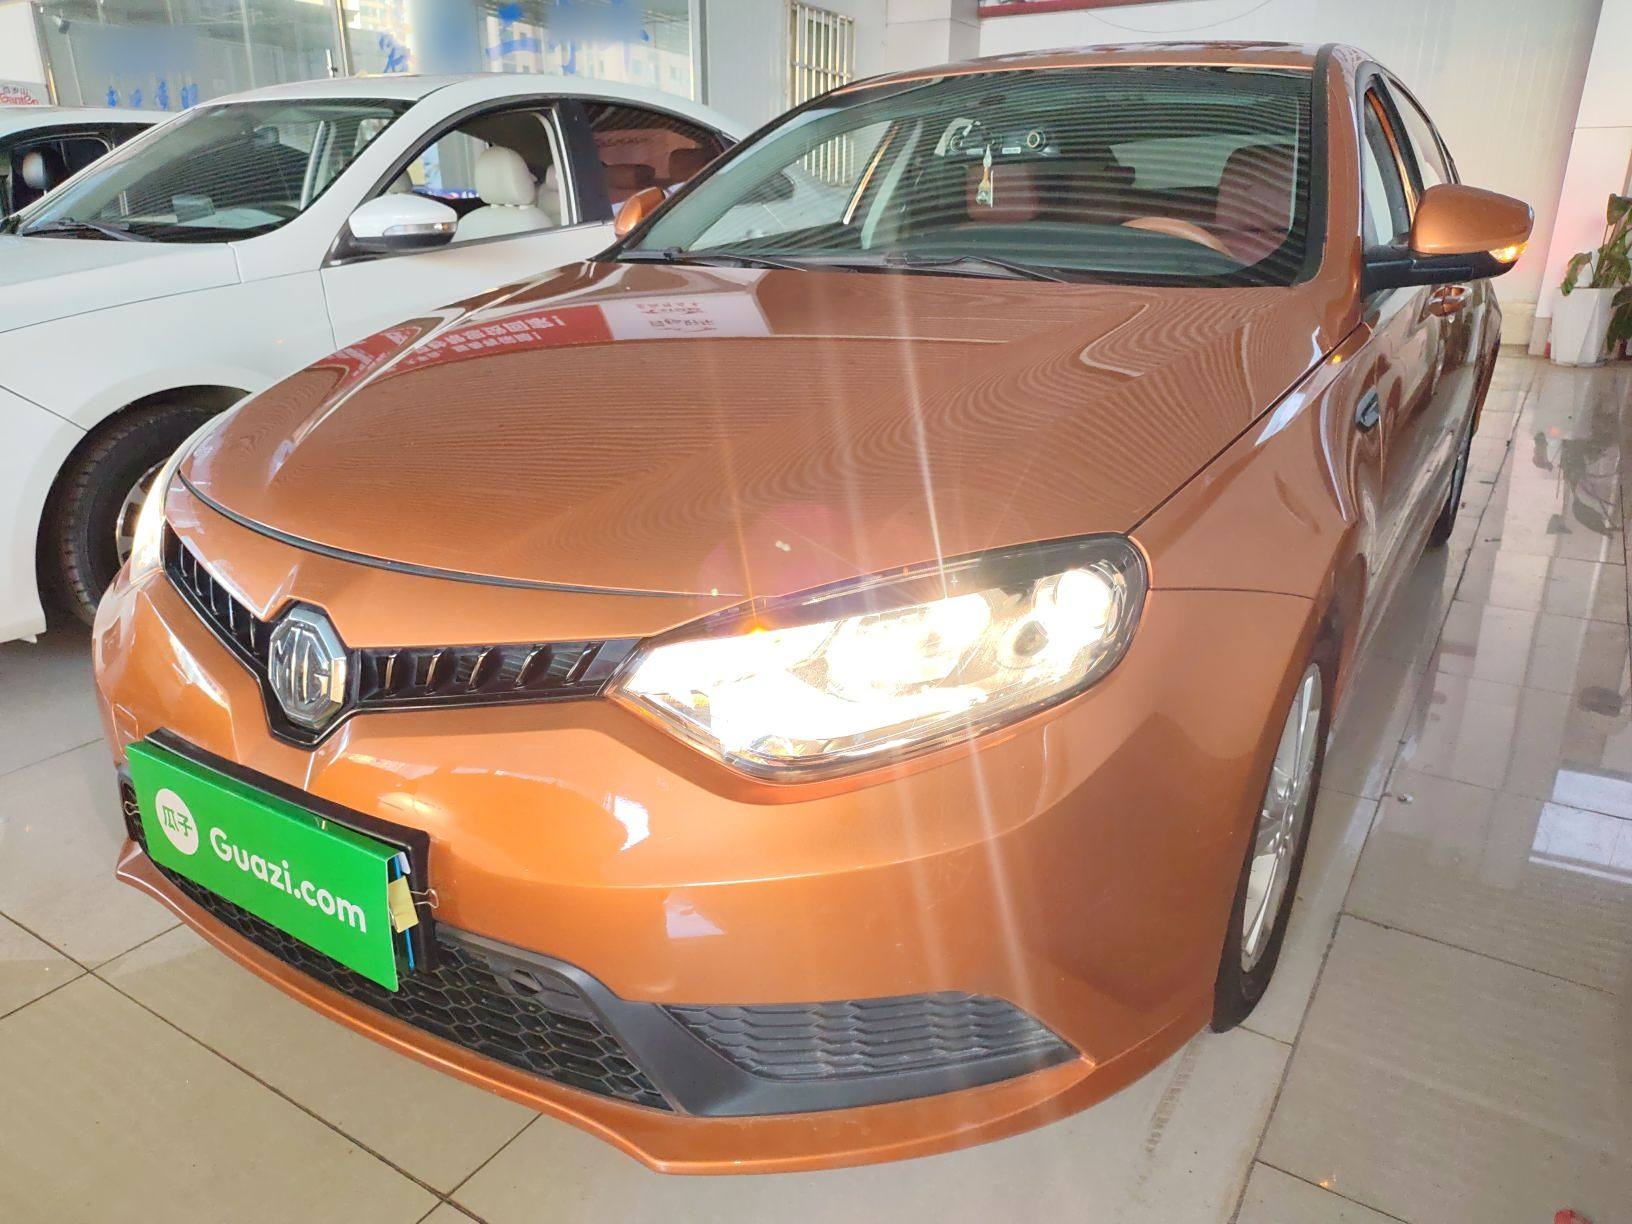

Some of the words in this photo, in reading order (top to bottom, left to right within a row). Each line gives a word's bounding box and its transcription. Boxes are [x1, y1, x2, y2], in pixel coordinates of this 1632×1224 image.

[273, 626, 331, 705] MG
[163, 806, 193, 837] 瓜子
[210, 827, 366, 933] Guazi.com
